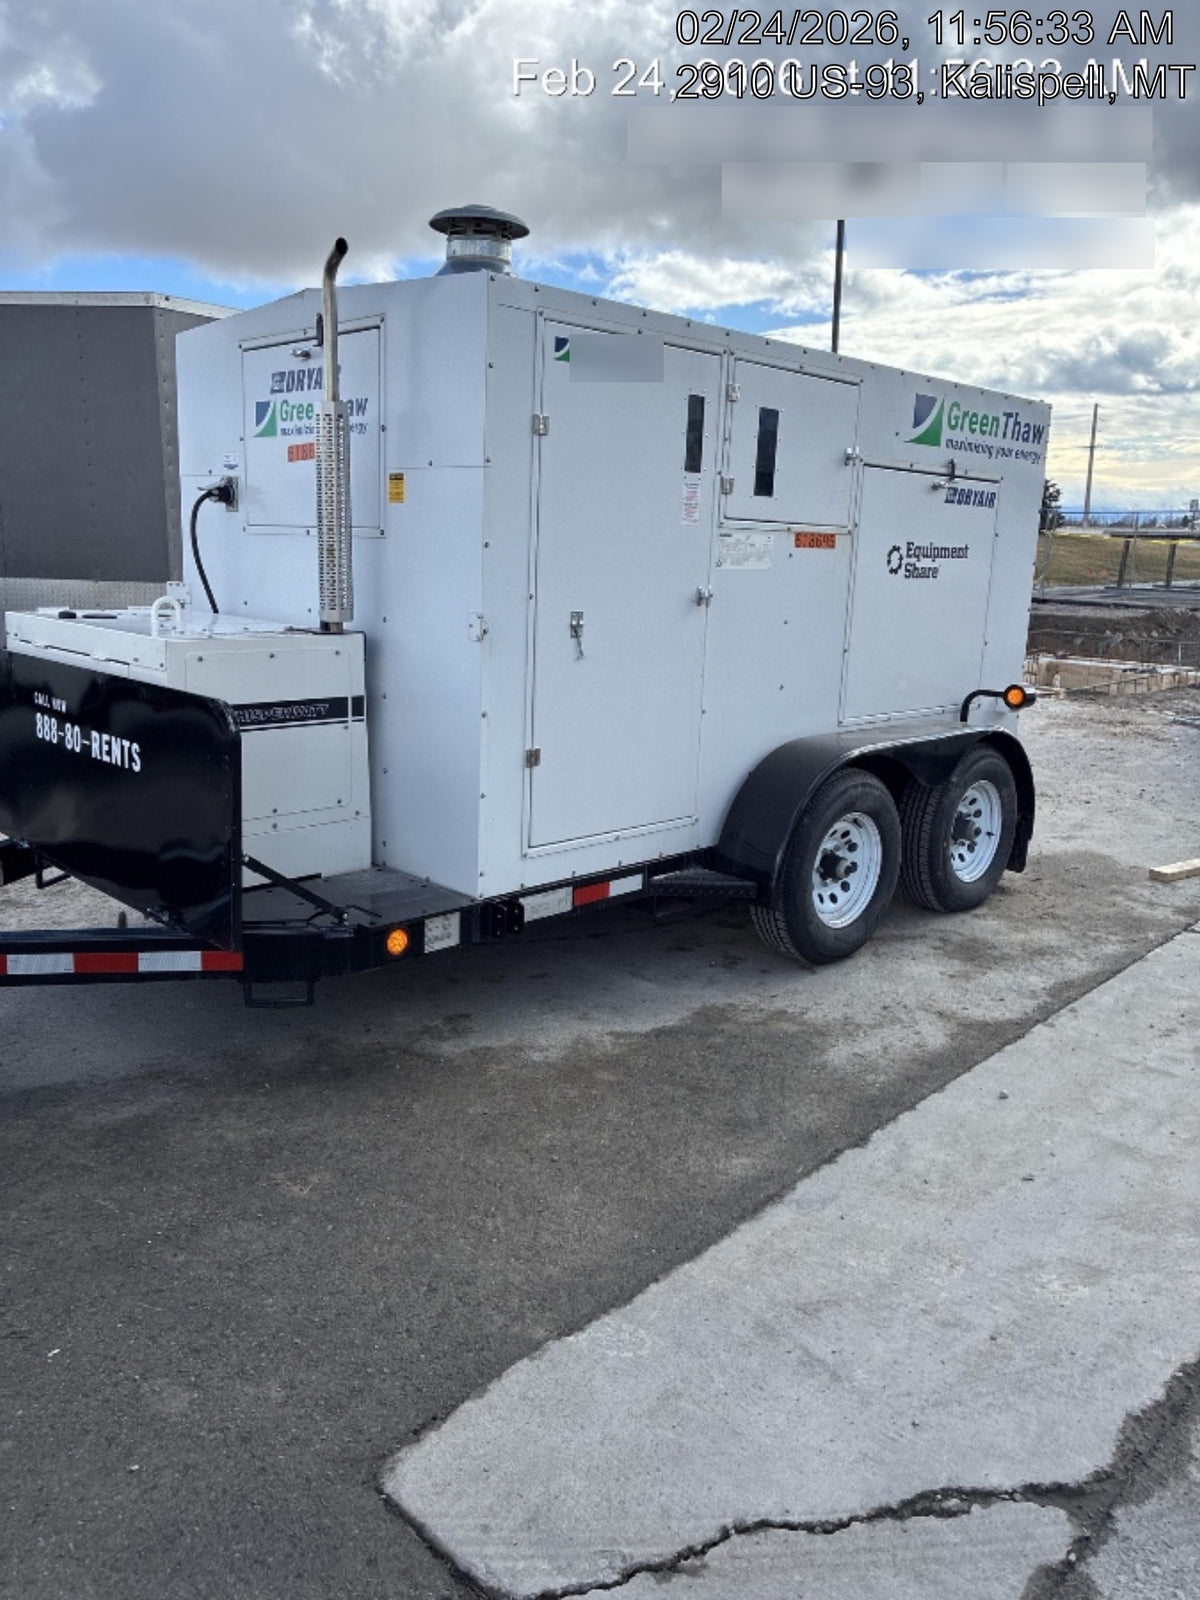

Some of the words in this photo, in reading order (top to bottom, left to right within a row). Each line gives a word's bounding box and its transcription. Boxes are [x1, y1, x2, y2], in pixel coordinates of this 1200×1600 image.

[285, 364, 341, 394] DRYA
[905, 541, 970, 563] Equipment
[904, 562, 940, 580] Share
[233, 703, 330, 723] HISPERWATT
[36, 712, 141, 773] 888-80-RENTS
